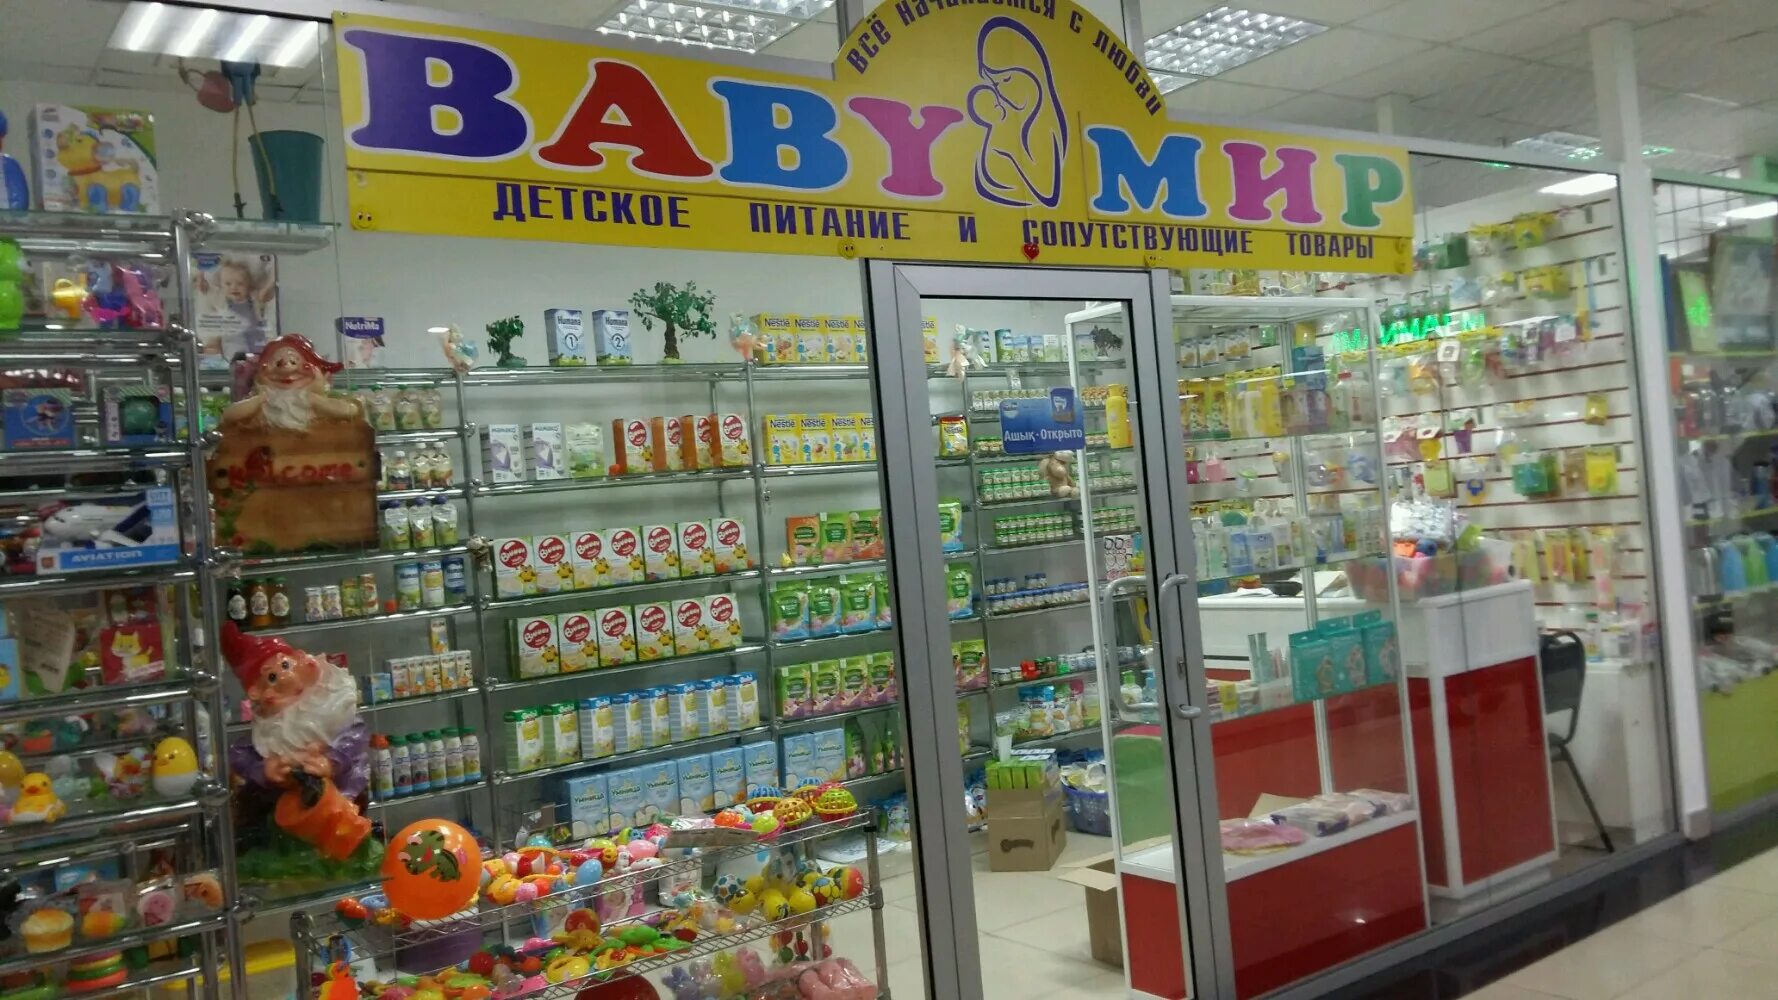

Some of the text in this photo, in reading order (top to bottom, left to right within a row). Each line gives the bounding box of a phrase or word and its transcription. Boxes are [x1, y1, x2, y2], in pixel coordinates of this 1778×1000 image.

[343, 29, 1404, 228] BABY МИР
[492, 182, 1374, 260] ДЕТСКОЕ ПИТАНИЕ И СОПУТСТВУЮЩИЕ ТОВАРЫ
[1040, 428, 1083, 442] Открыто
